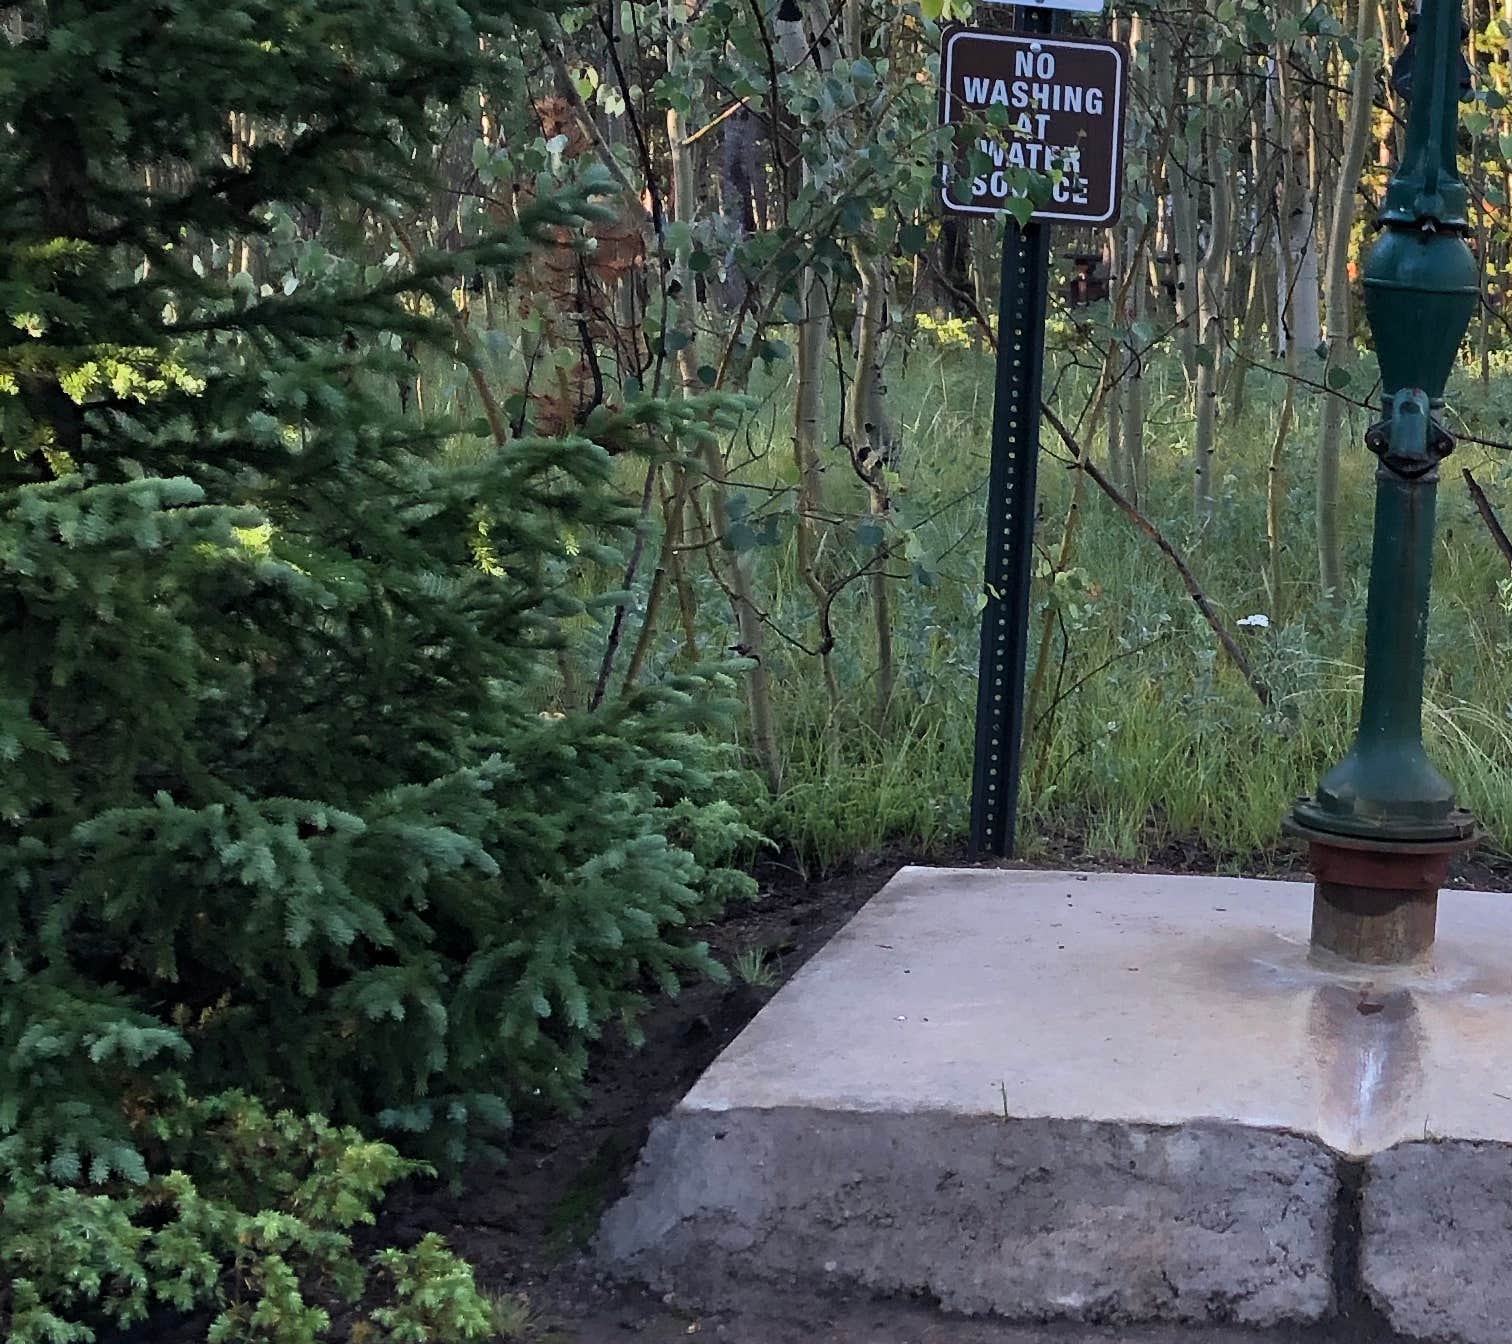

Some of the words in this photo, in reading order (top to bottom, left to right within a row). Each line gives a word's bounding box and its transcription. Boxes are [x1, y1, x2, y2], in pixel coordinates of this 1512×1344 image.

[1015, 50, 1056, 80] NO
[963, 76, 1104, 115] WASHING
[1014, 112, 1051, 140] AT
[971, 170, 1089, 205] SOCE
